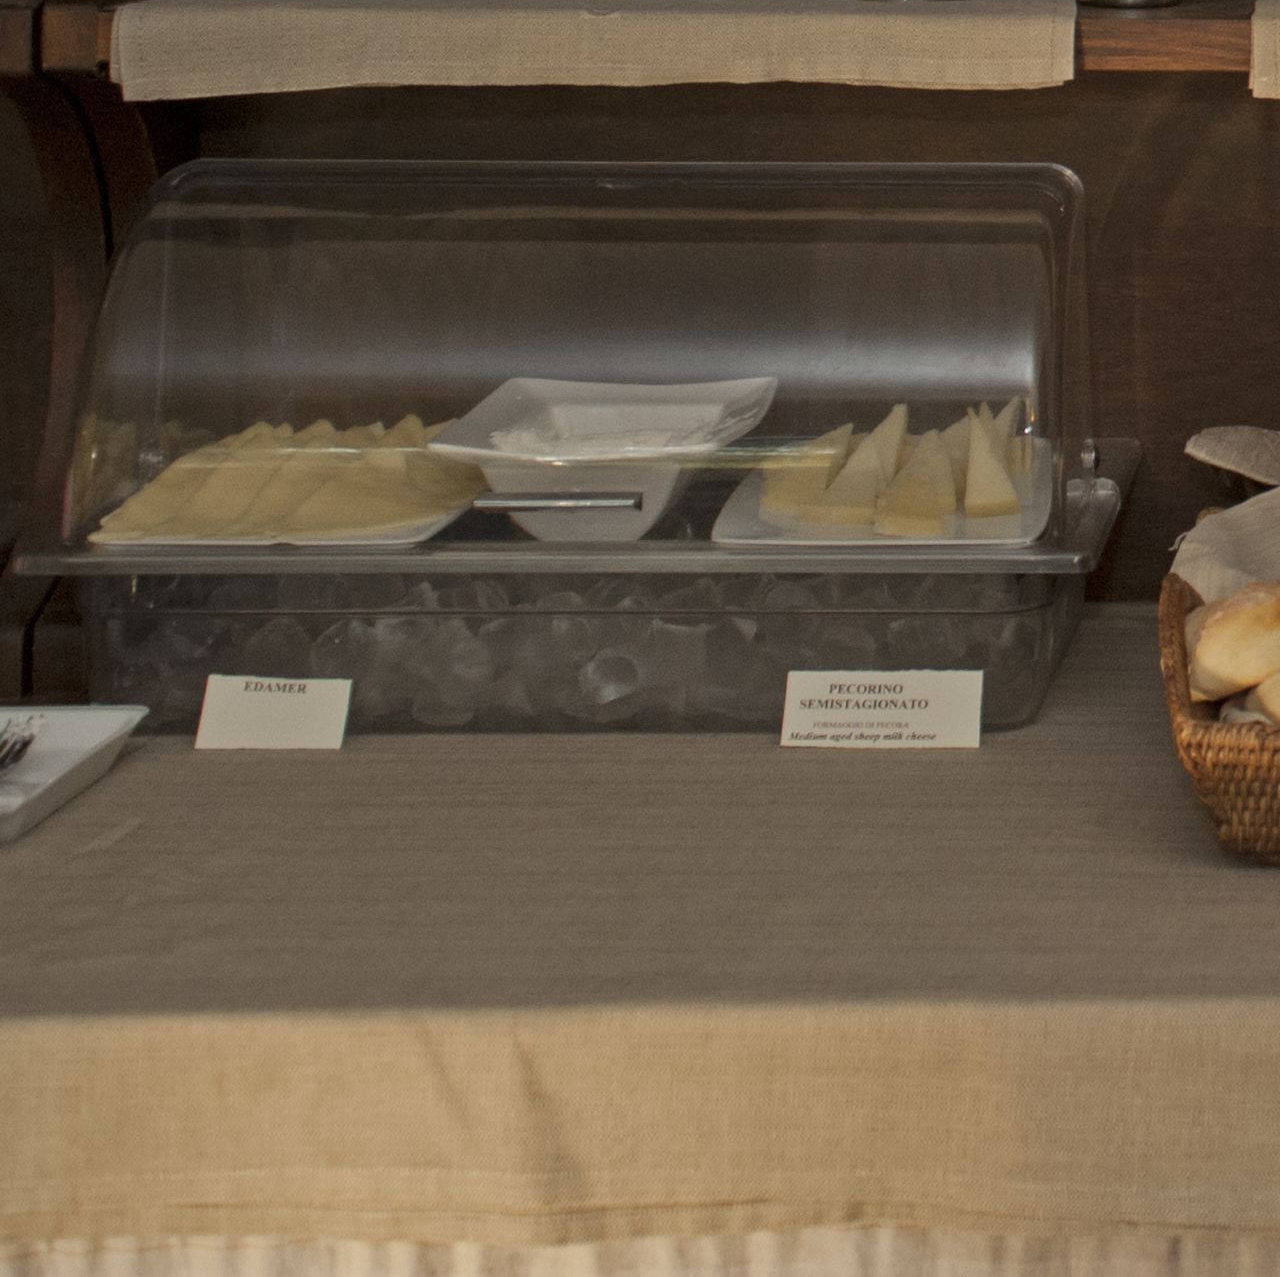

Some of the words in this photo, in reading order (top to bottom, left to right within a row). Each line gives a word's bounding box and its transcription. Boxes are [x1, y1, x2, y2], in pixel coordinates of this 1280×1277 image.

[244, 681, 307, 694] EDAMER
[829, 684, 904, 695] PECORINO
[799, 699, 929, 710] SEMISTAGIONATO
[791, 732, 828, 740] Medium
[829, 733, 853, 742] aged
[855, 732, 881, 743] sheep
[882, 732, 902, 740] milk
[905, 732, 937, 740] cheese
